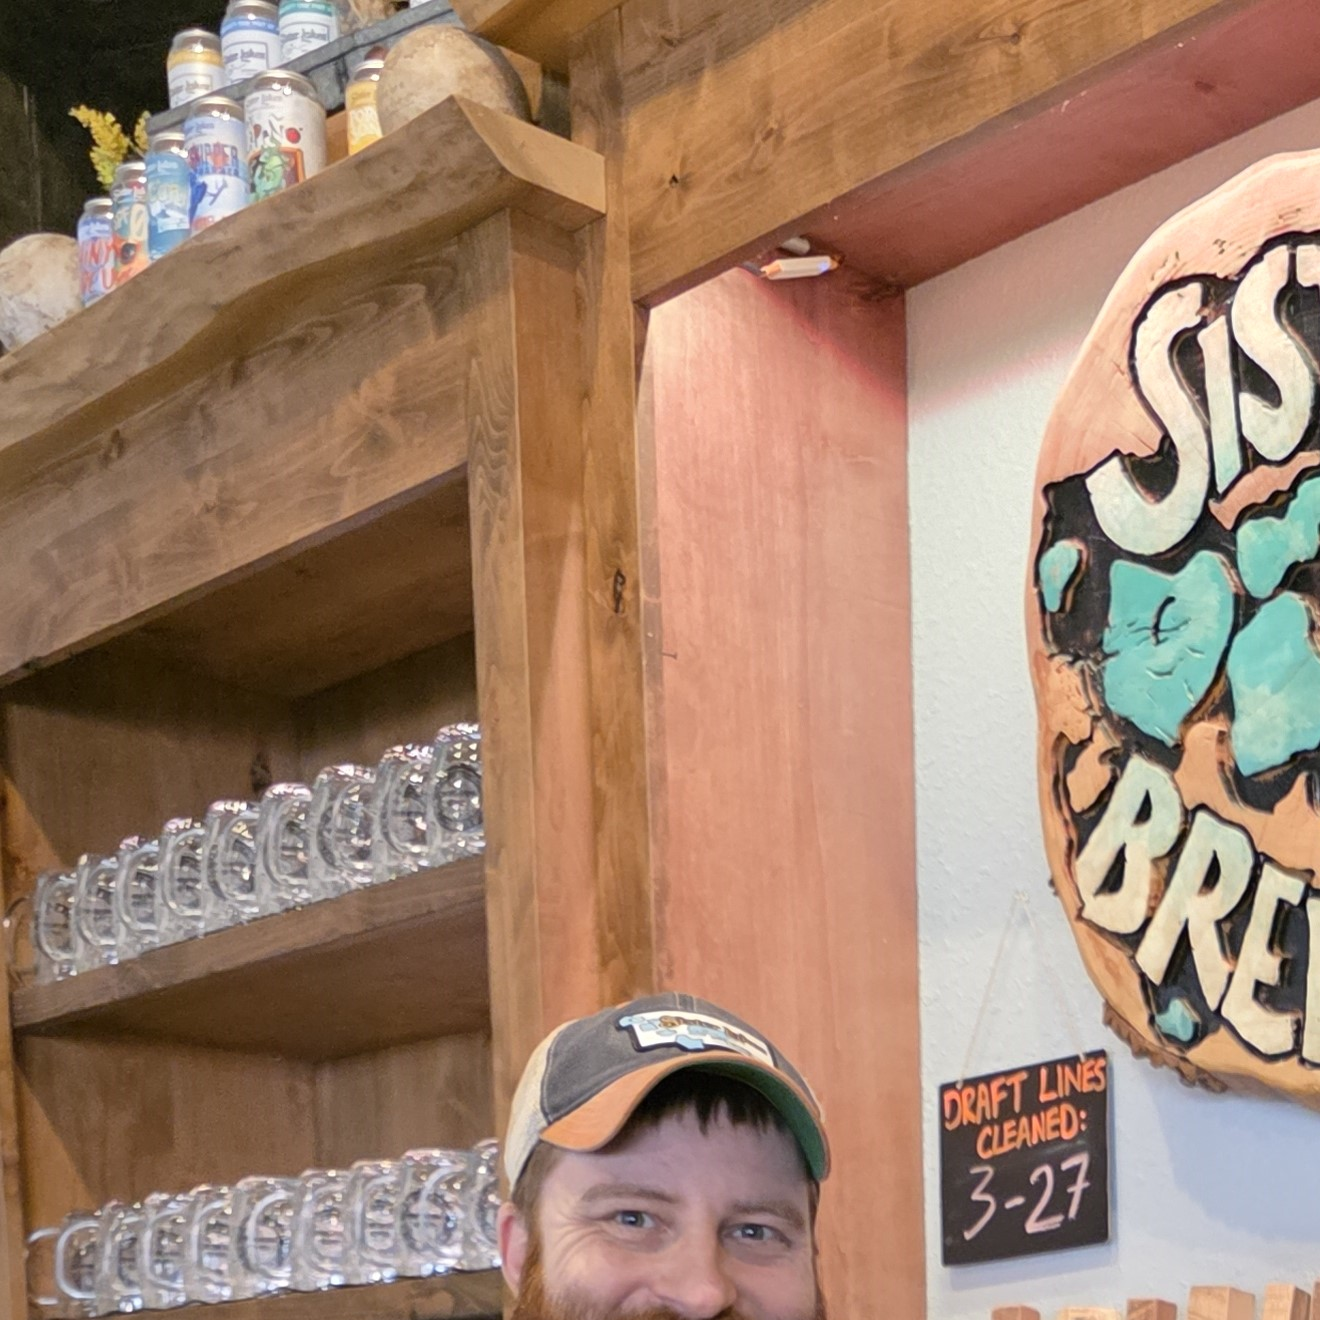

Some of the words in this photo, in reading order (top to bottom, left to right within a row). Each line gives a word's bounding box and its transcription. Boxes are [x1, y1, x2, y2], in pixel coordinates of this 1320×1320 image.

[943, 1070, 1029, 1131] DRAFT
[1039, 1058, 1107, 1103] LINES
[976, 1103, 1088, 1160] CLEANED:
[963, 1152, 1091, 1241] 3-27
